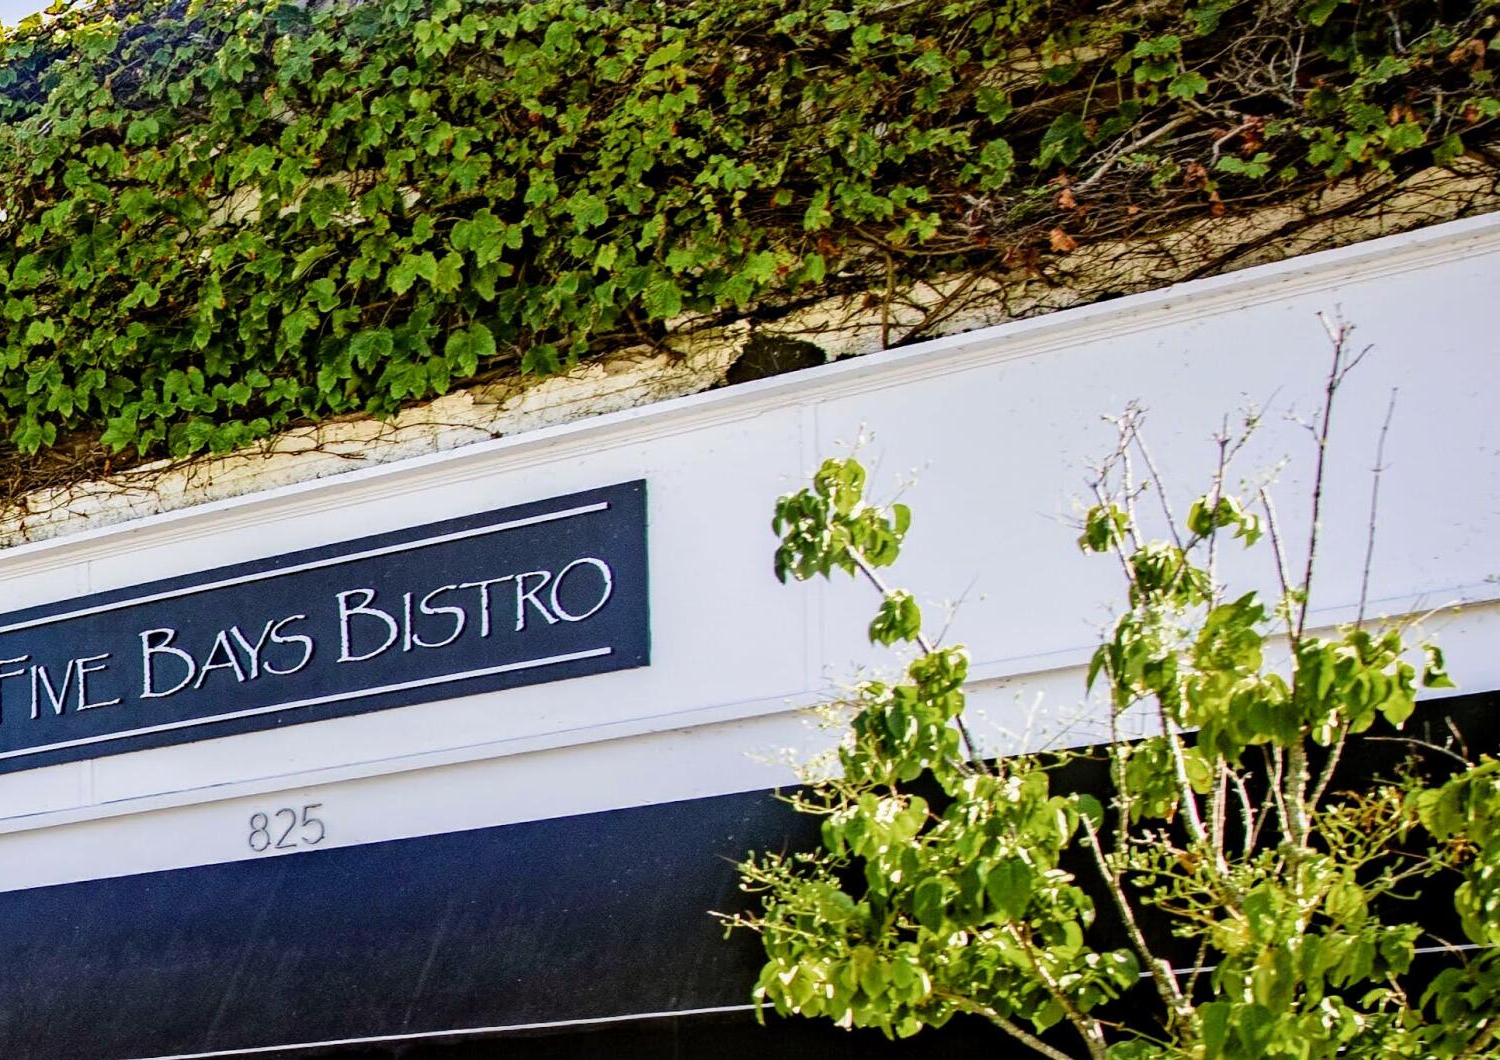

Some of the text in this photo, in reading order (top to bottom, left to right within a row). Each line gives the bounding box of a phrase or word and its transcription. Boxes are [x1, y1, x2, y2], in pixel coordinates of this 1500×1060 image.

[139, 614, 314, 699] BAYS
[336, 557, 613, 664] BISTRO
[247, 803, 326, 852] 825
